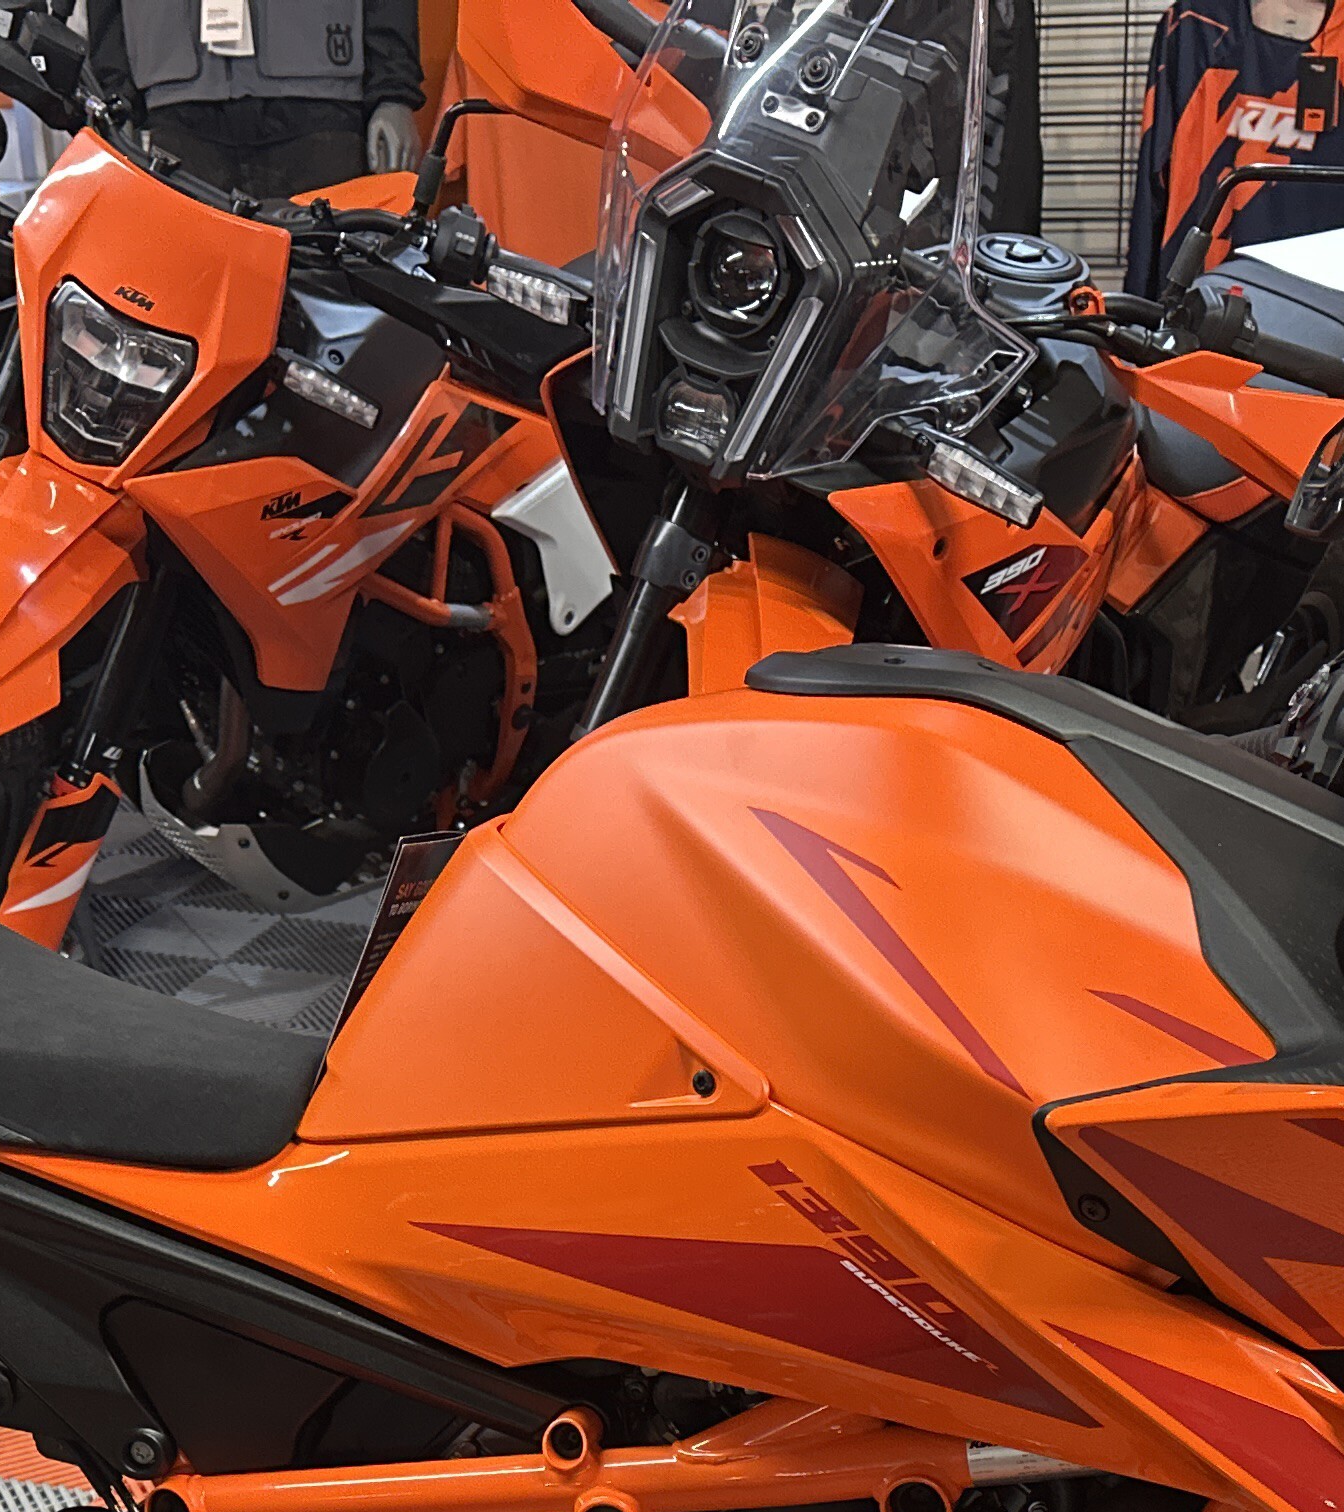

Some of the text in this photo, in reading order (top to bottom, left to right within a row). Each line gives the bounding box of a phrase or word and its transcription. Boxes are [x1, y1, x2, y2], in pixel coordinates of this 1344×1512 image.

[1226, 100, 1317, 151] KTM
[114, 286, 155, 311] KTM
[260, 491, 301, 520] KTM
[980, 546, 1060, 615] 390 X
[747, 1159, 976, 1332] 1390
[839, 1259, 982, 1363] SUPERDUKE
